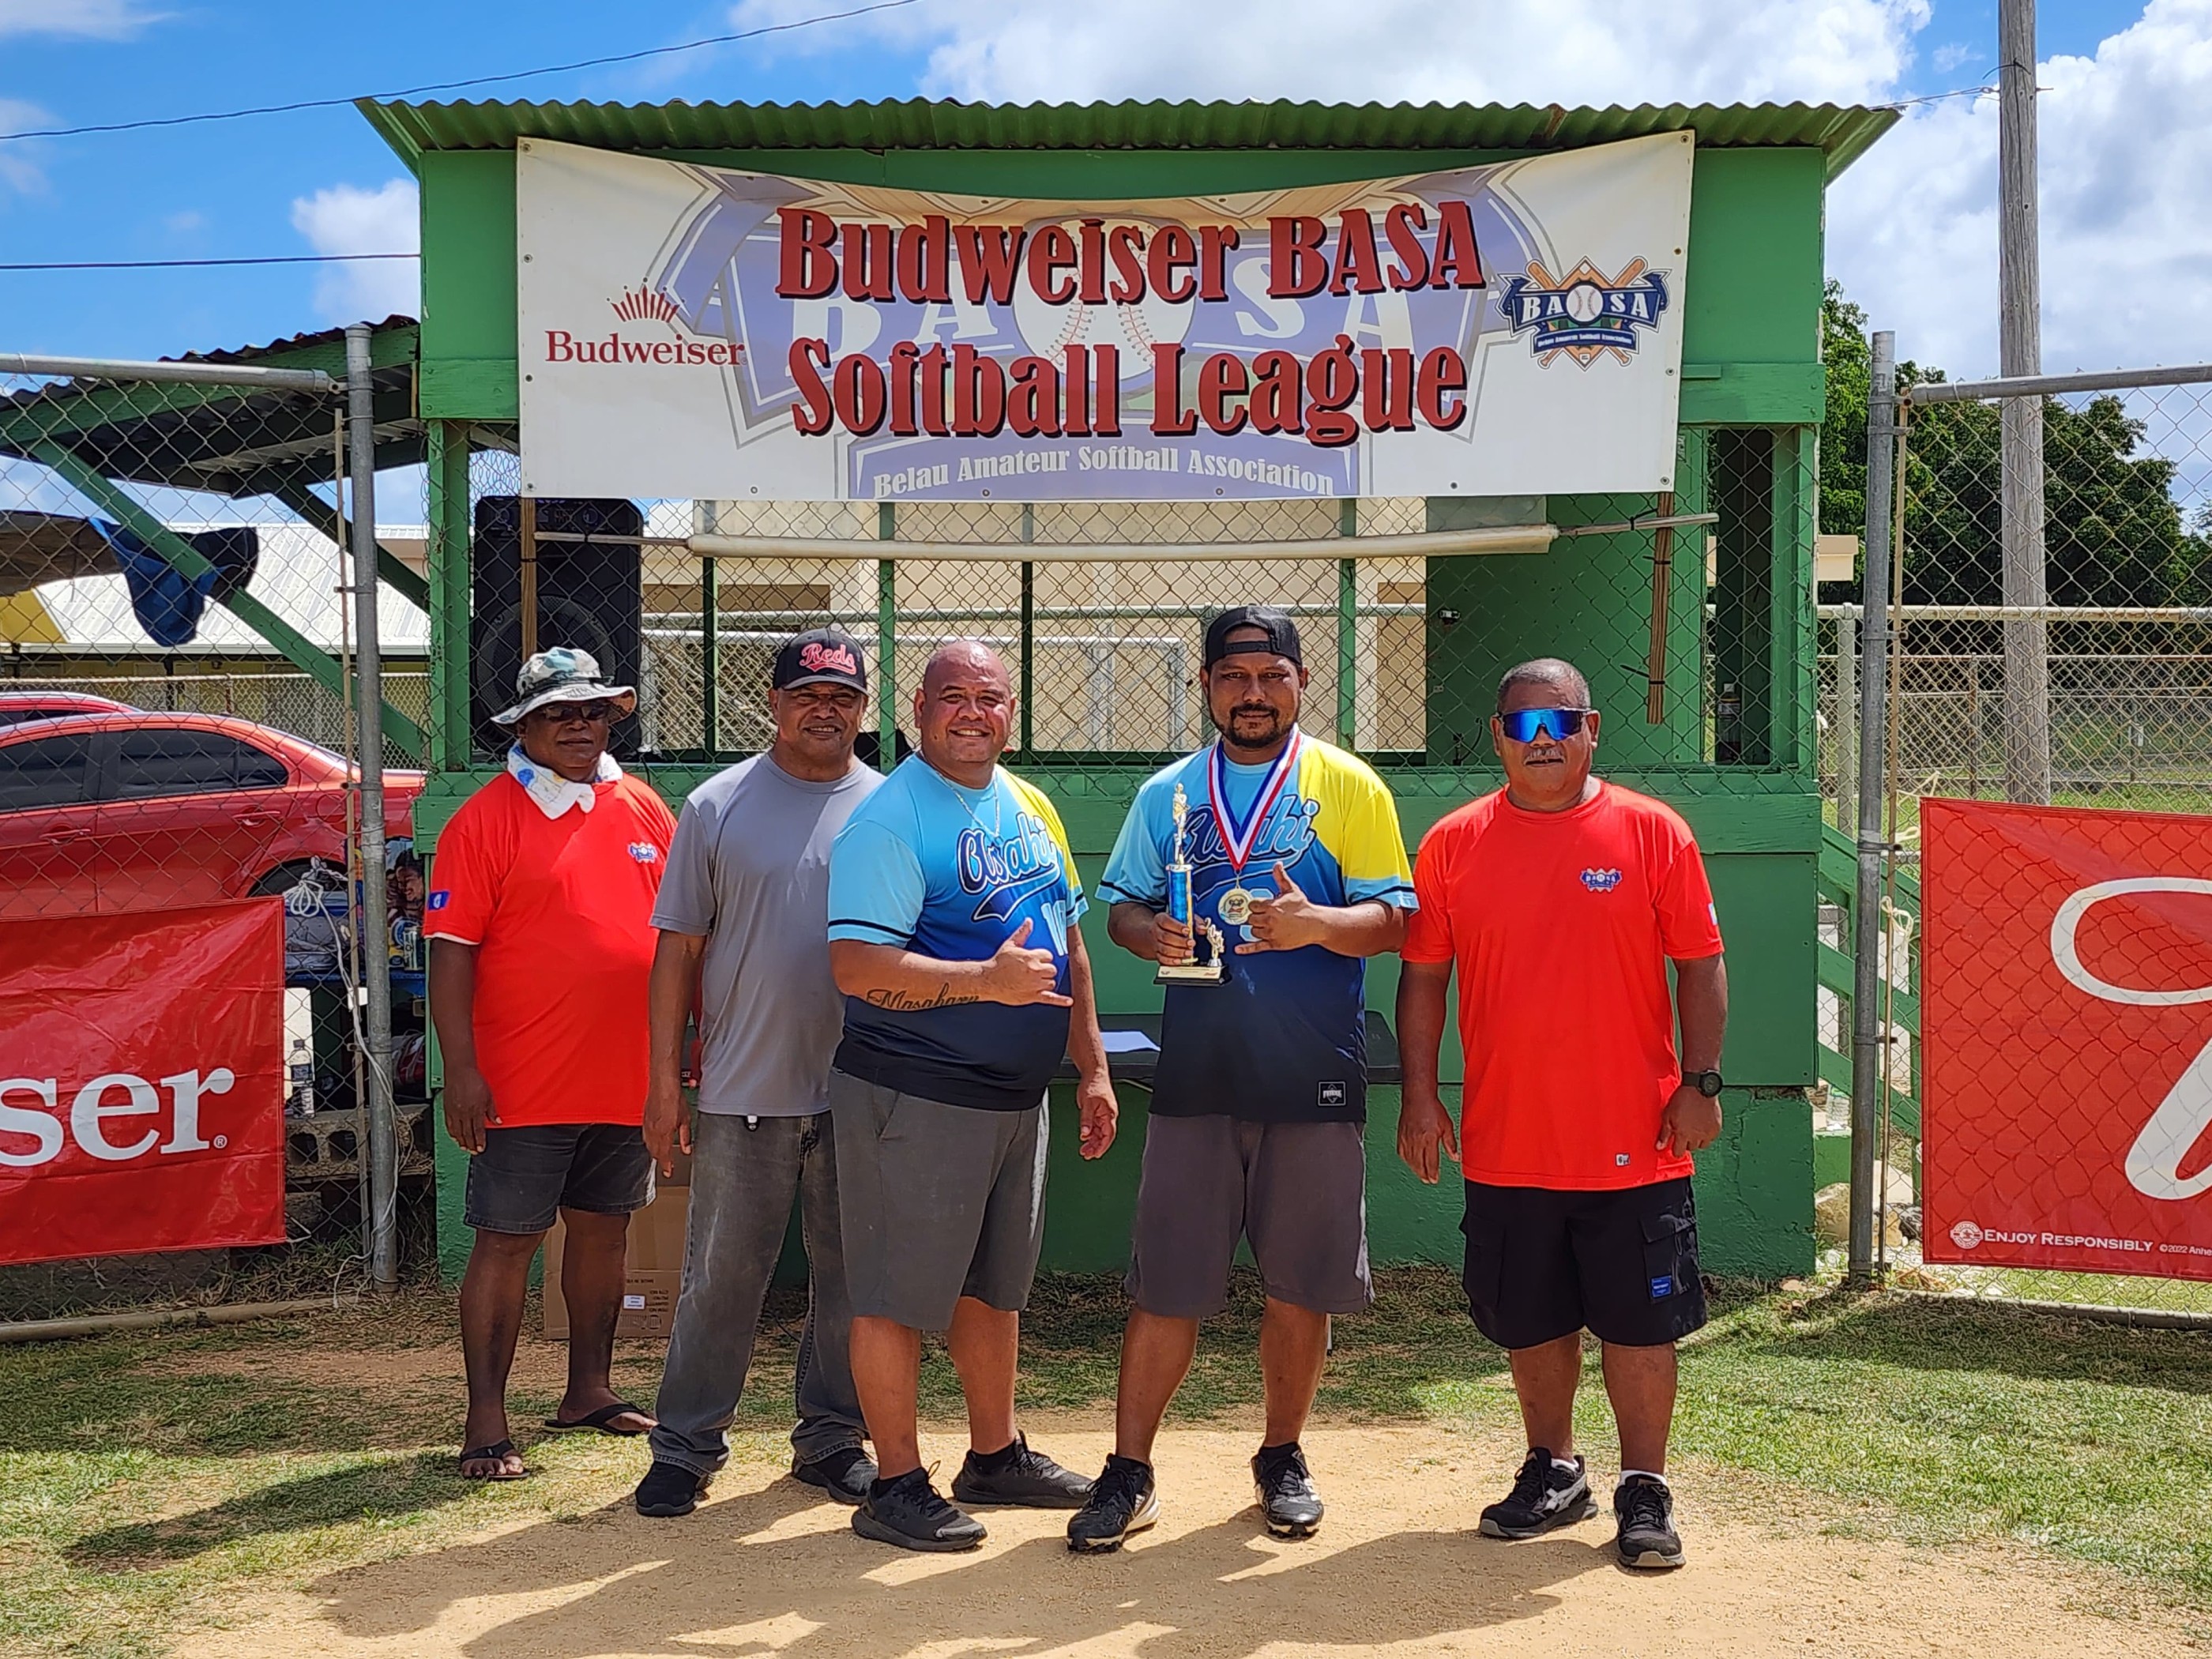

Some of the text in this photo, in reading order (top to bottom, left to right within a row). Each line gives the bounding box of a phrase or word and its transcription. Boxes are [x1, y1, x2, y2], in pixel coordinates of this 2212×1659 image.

[775, 201, 1486, 306] Budweiser BASA
[544, 329, 746, 366] Budweiser
[789, 334, 1468, 448] Softball League
[873, 445, 1334, 499] Belau Amateur Softball Association
[799, 642, 856, 668] Reds
[956, 811, 1057, 895] Asahi
[1984, 1228, 2037, 1244] ENJOY
[2041, 1232, 2154, 1252] RESPONSIBLY
